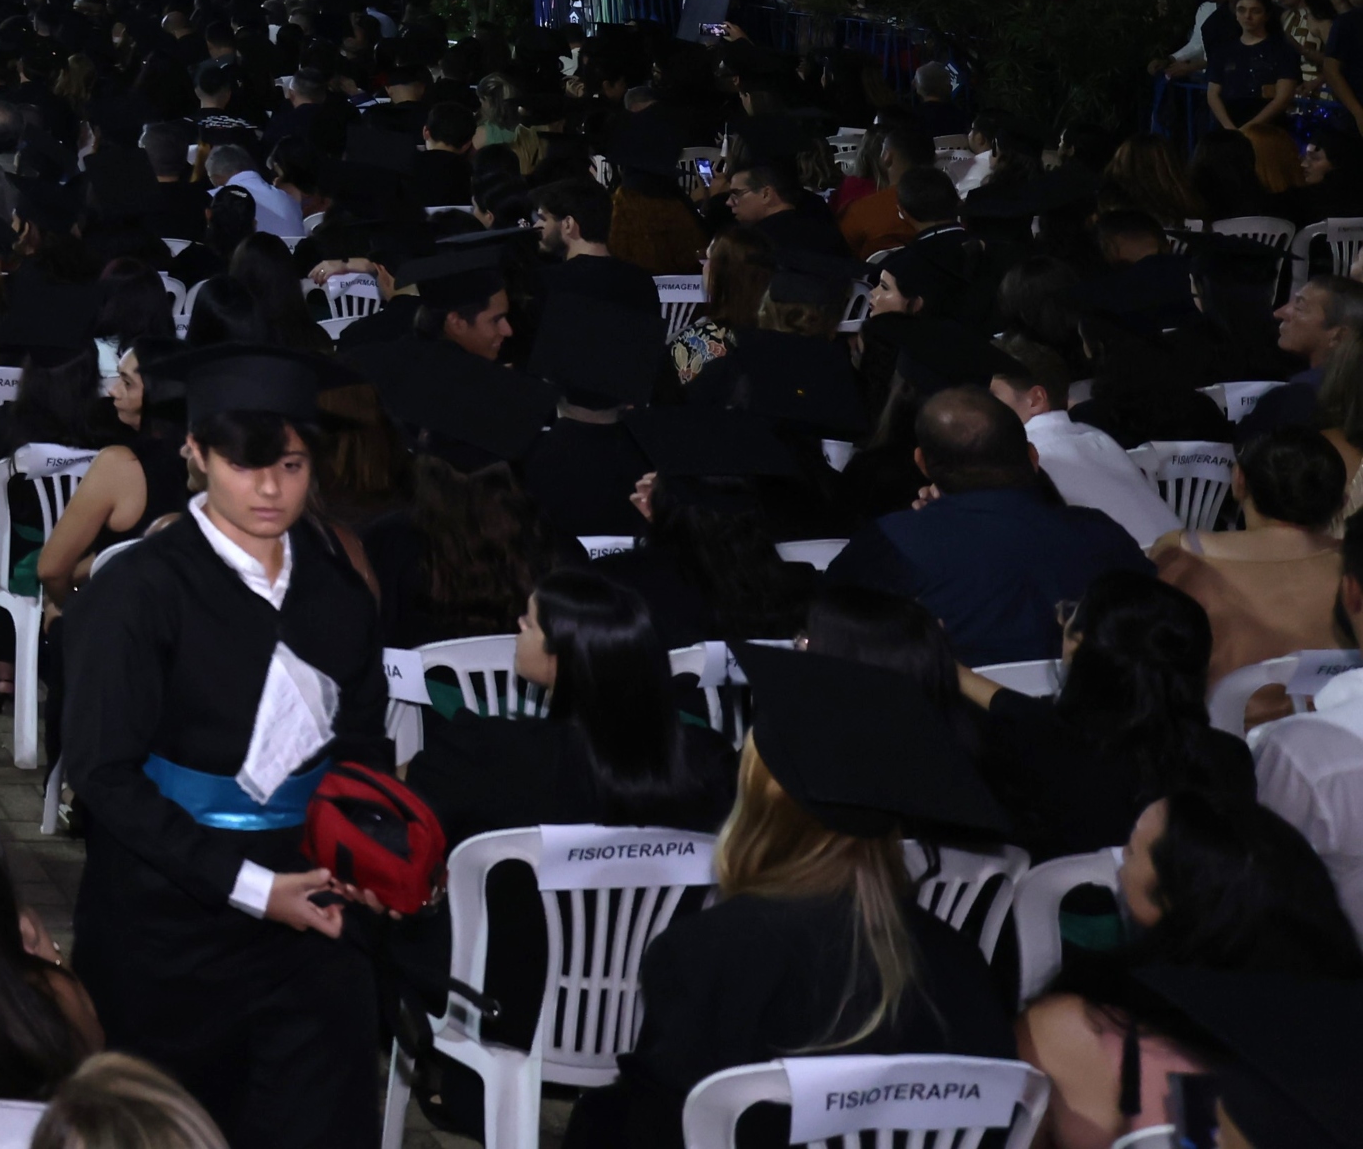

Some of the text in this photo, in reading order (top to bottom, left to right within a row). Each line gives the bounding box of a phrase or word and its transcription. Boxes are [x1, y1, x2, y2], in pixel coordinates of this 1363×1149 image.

[339, 278, 380, 289] ENFERMA
[657, 283, 701, 291] ERMAGEM
[567, 841, 696, 862] FISIOTERAPIA
[825, 1082, 981, 1111] FISIOTERAPIA
